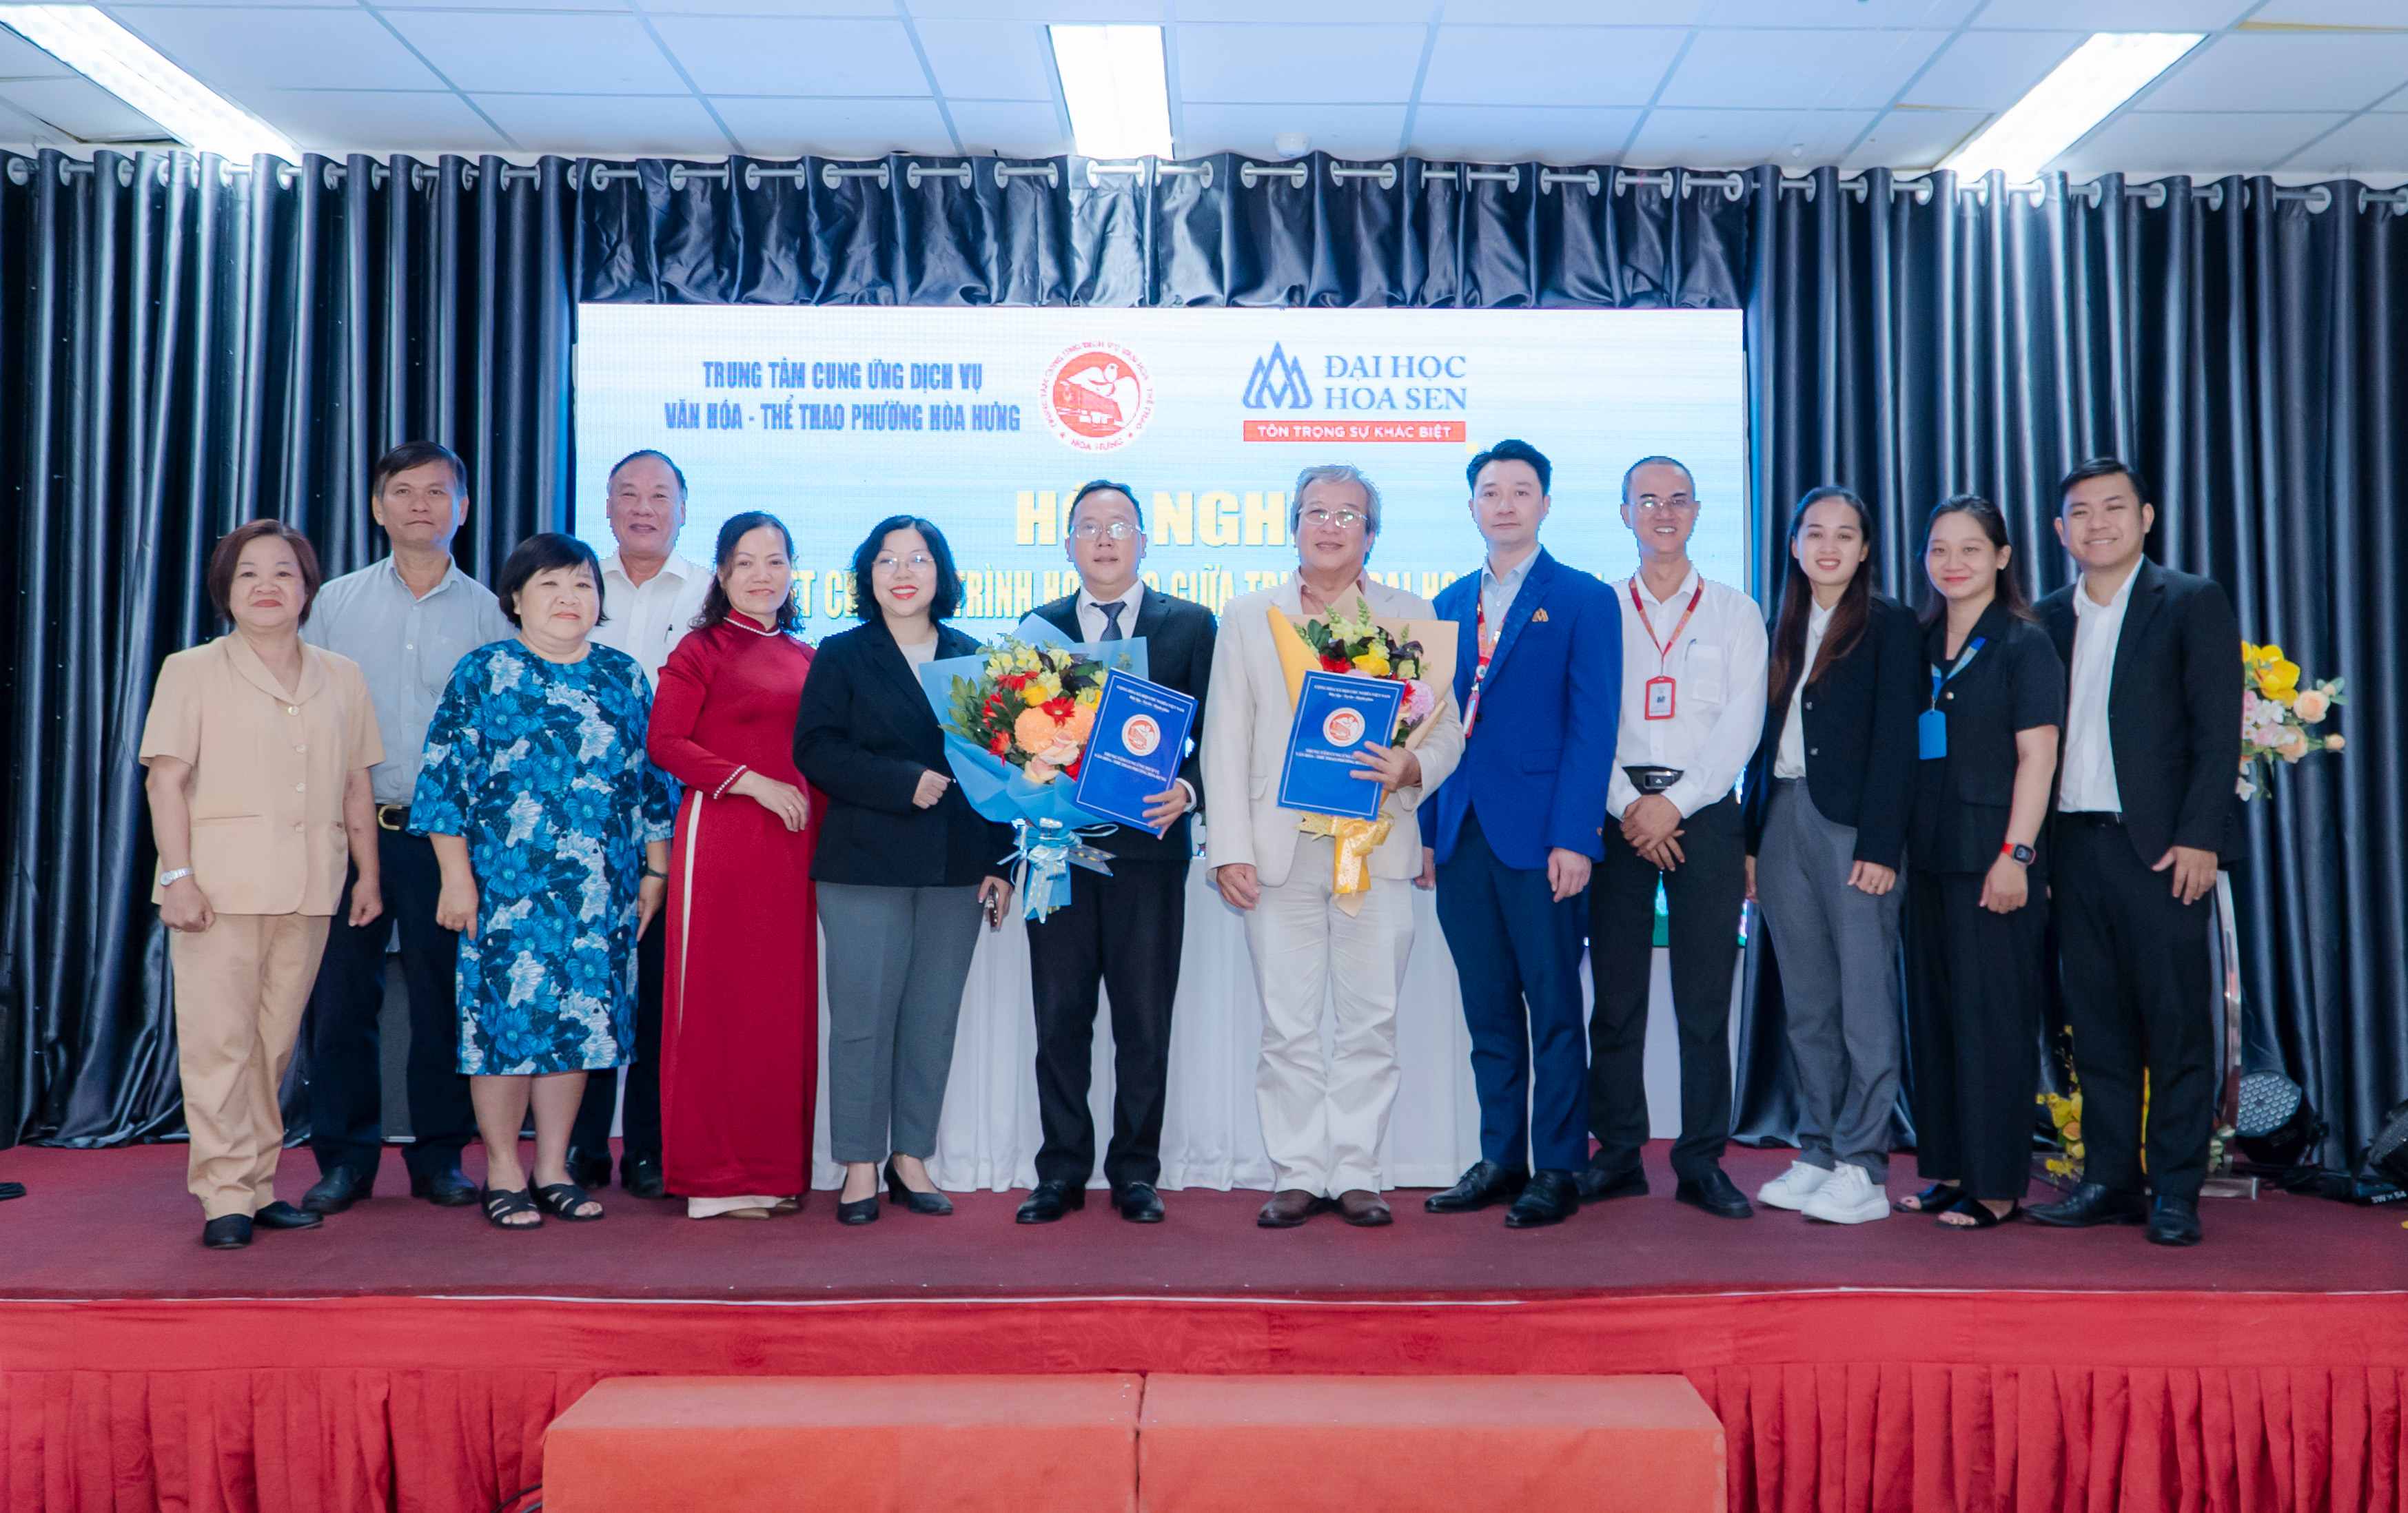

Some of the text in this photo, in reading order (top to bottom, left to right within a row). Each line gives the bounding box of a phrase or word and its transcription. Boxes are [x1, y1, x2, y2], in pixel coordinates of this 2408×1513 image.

[702, 356, 982, 394] TRUNG TÂM CUNG ỨNG DỊCH VỤ
[1325, 355, 1467, 382] ĐẠI HỌC
[664, 399, 700, 429] VĂN
[706, 399, 742, 430] HÓA
[759, 394, 793, 429] THỂ
[799, 403, 844, 430] THAO
[852, 398, 923, 431] PHƯỜNG
[930, 400, 966, 431] HÒA
[972, 401, 1020, 431] HƯNG
[1325, 387, 1467, 410] HOA SEN
[1257, 423, 1452, 440] TÔN TRỌNG SỰ KHÁC BIỆT
[1153, 490, 1295, 548] NGH
